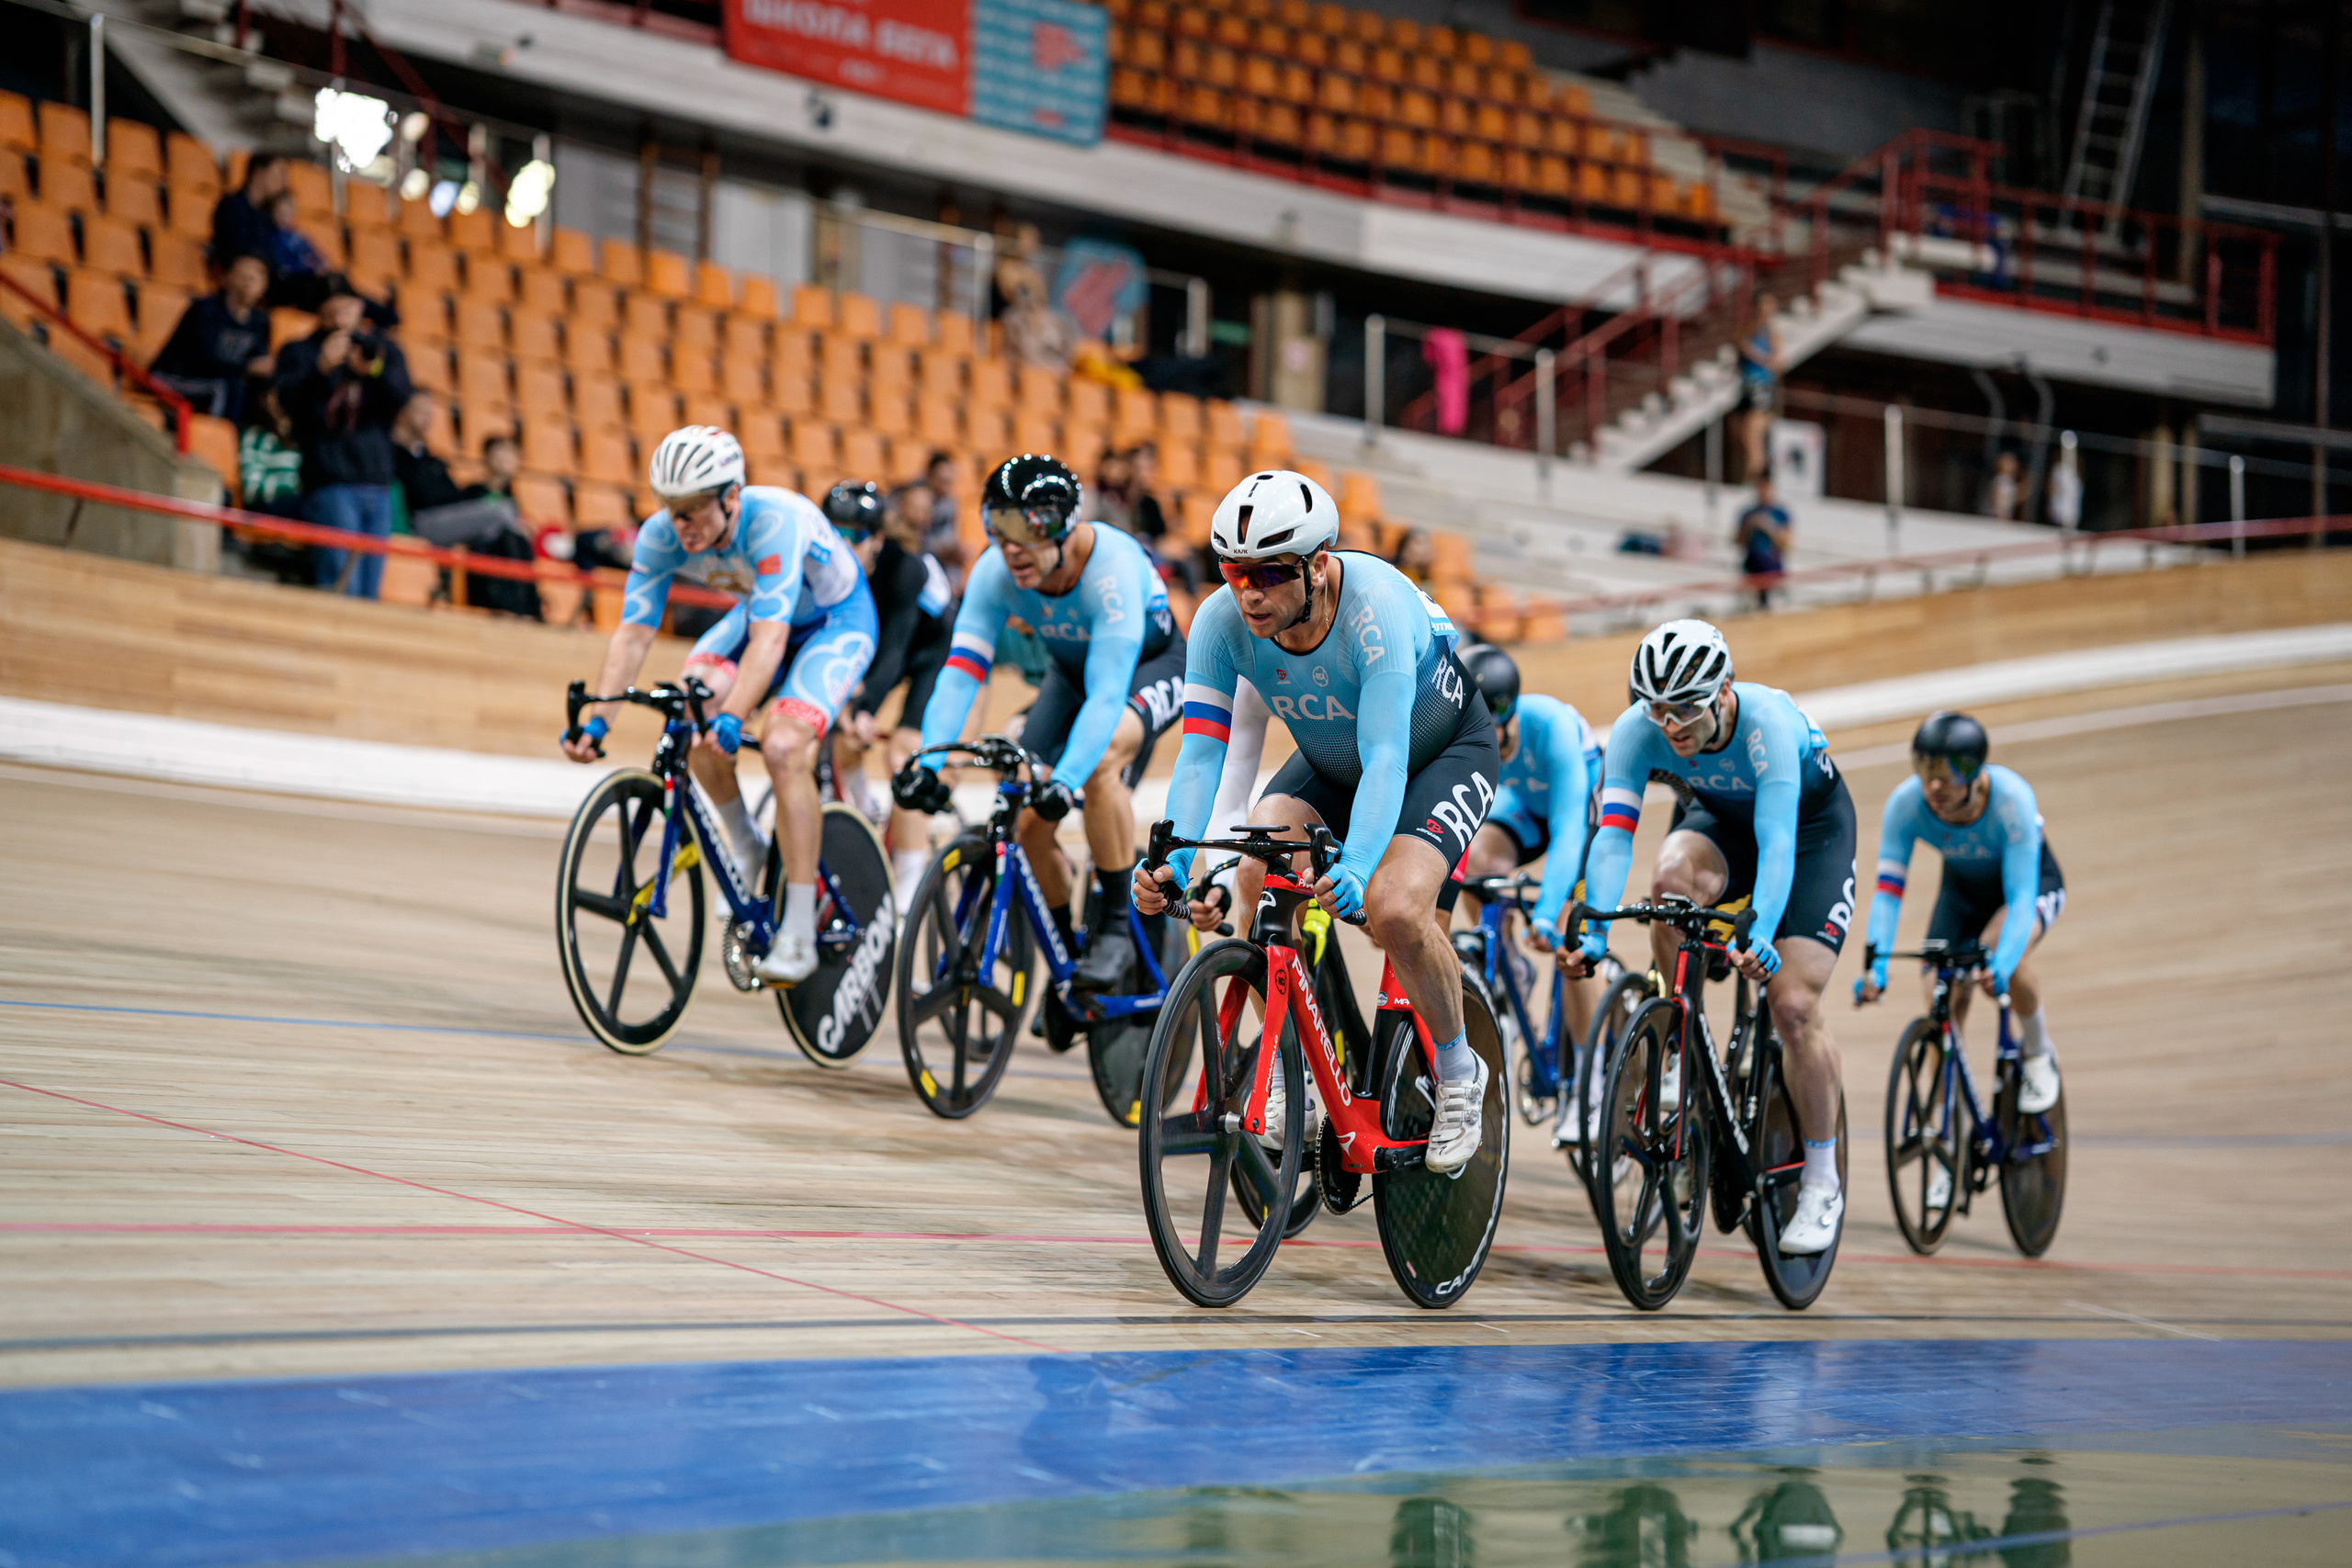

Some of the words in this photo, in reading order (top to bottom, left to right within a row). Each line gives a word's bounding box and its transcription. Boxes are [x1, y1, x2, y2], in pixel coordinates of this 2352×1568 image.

[1094, 575, 1125, 625] RCA
[1351, 604, 1385, 666] RCA
[1271, 694, 1357, 721] RCA
[1431, 654, 1464, 710] RCA
[1746, 728, 1769, 779] RCA
[1686, 774, 1754, 792] RCA
[1430, 771, 1495, 853] RCA
[817, 891, 894, 1055] CARBON
[1291, 953, 1352, 1107] PINARELLO
